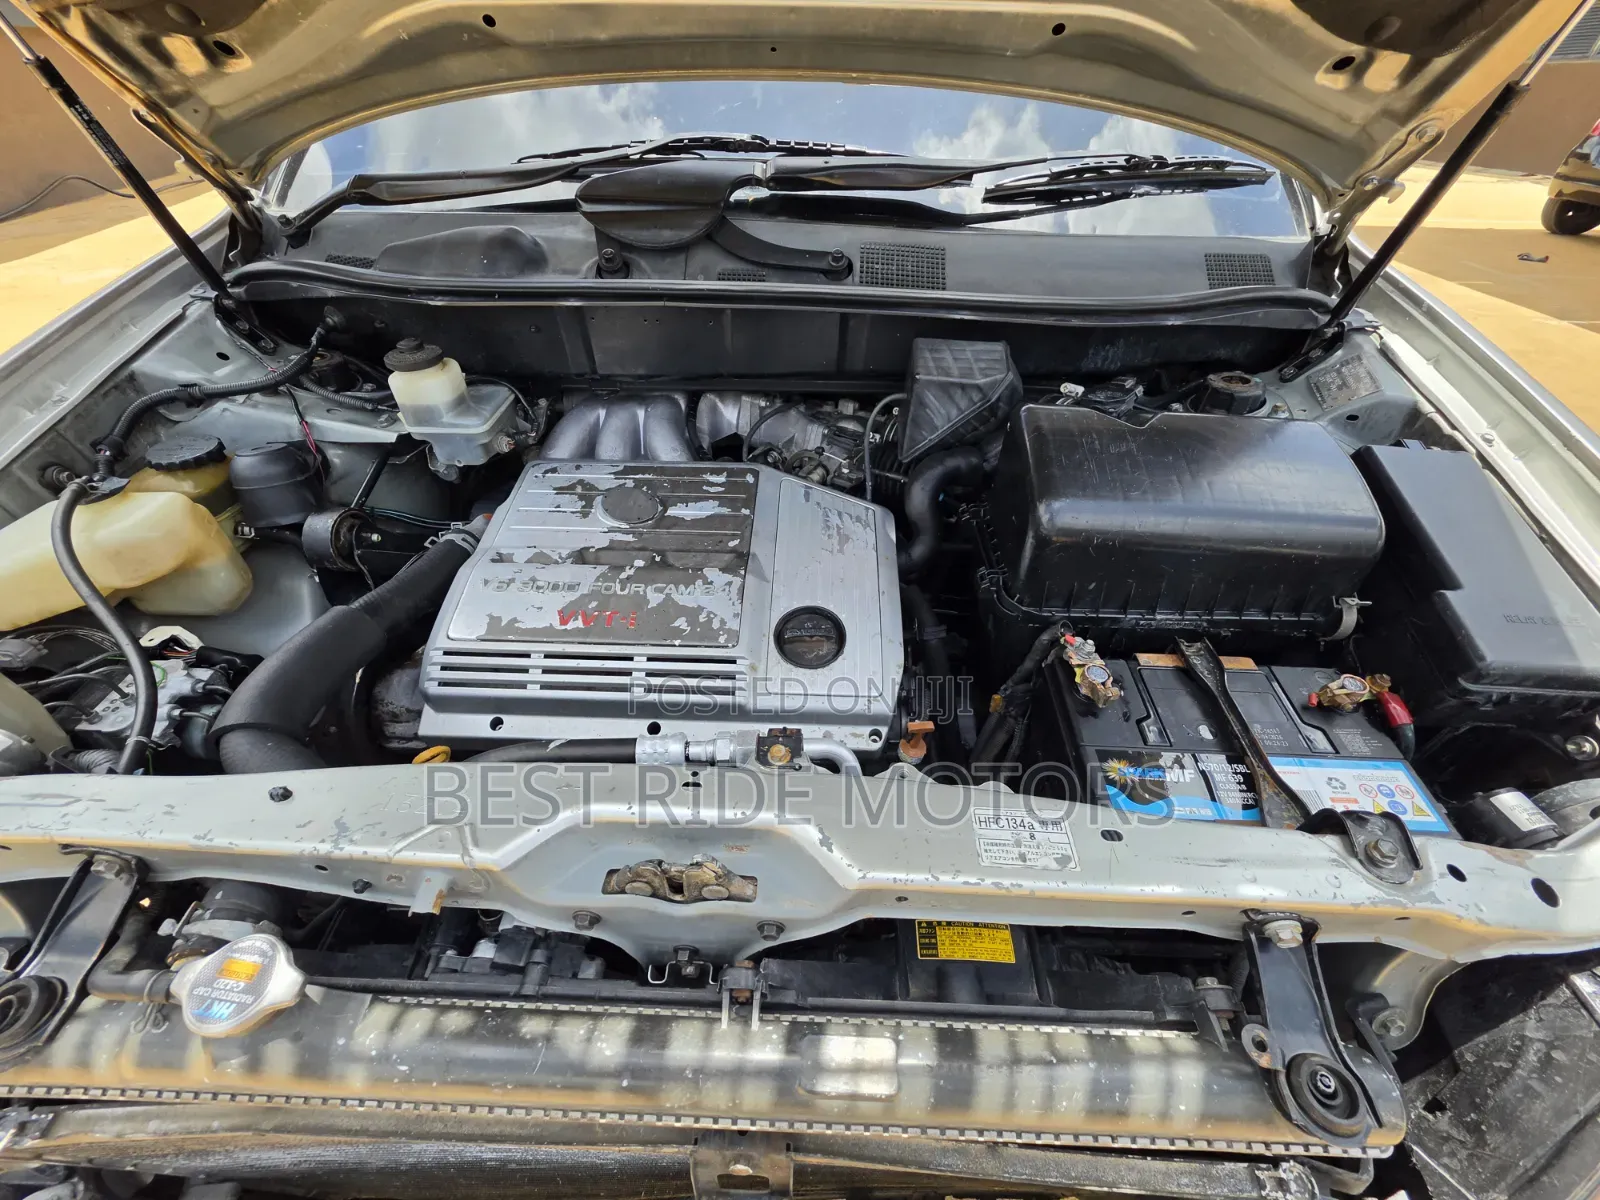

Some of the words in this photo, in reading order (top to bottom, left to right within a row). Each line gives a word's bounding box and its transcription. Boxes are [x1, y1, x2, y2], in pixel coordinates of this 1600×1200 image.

[517, 579, 580, 594] 3000
[588, 579, 646, 595] FOUR
[650, 583, 696, 596] CAM
[1165, 768, 1195, 783] MF
[1213, 772, 1227, 782] MF
[1227, 773, 1244, 783] 639
[977, 815, 1036, 831] HFC134a
[1028, 832, 1037, 841] 8
[192, 986, 212, 996] CAP
[211, 989, 255, 1004] RADIATOR
[191, 998, 237, 1020] HKT
